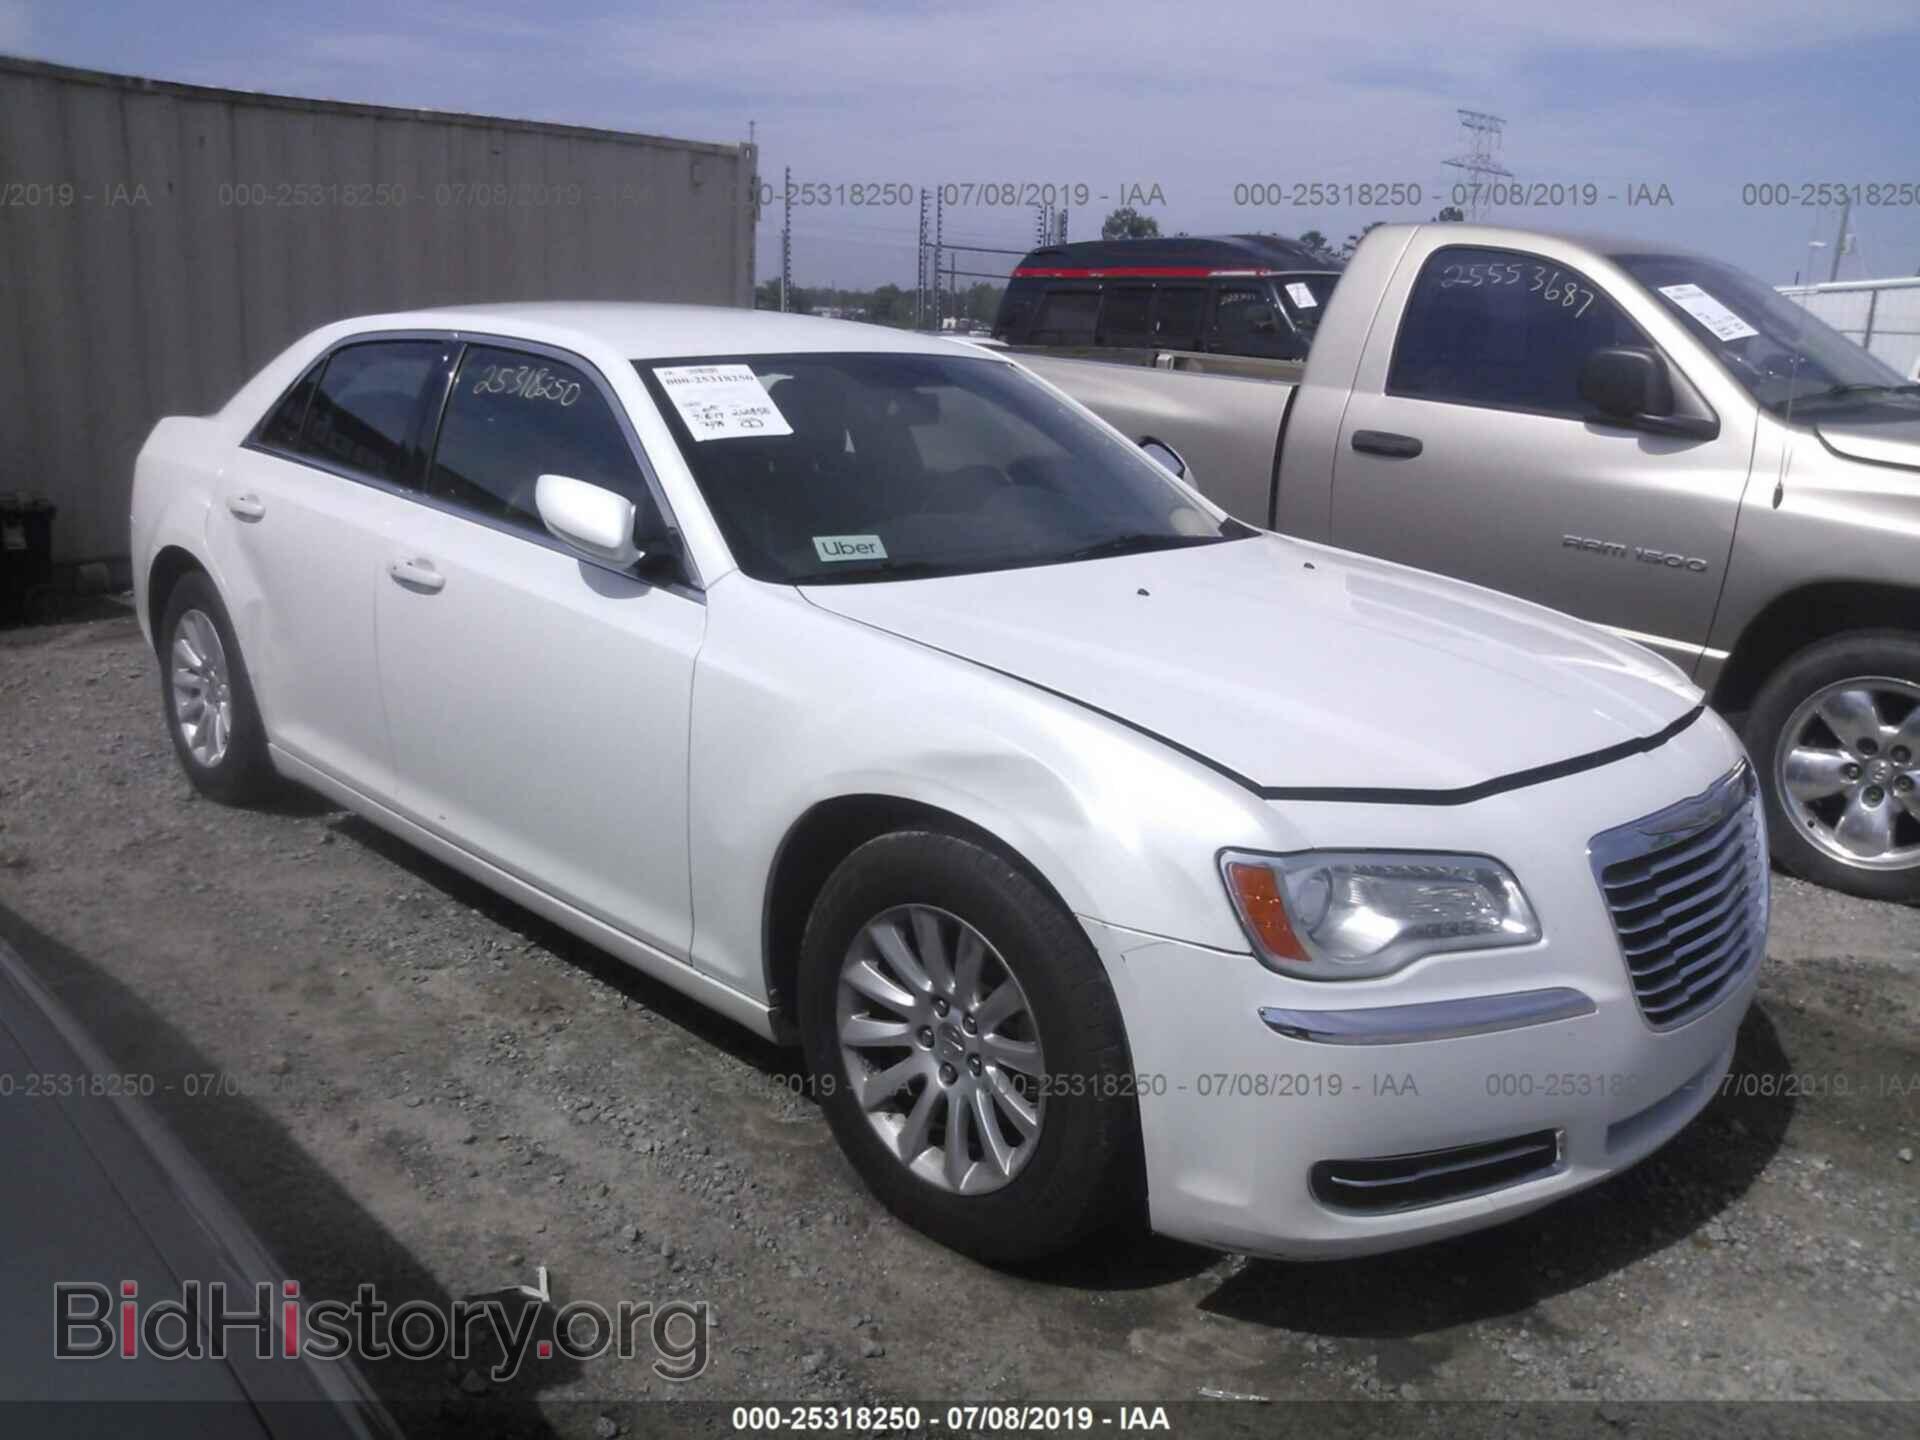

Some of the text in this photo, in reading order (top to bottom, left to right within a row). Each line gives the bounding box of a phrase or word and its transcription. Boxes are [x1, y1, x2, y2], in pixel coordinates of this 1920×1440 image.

[821, 541, 876, 556] Uber
[1562, 534, 1708, 572] RAM 1500
